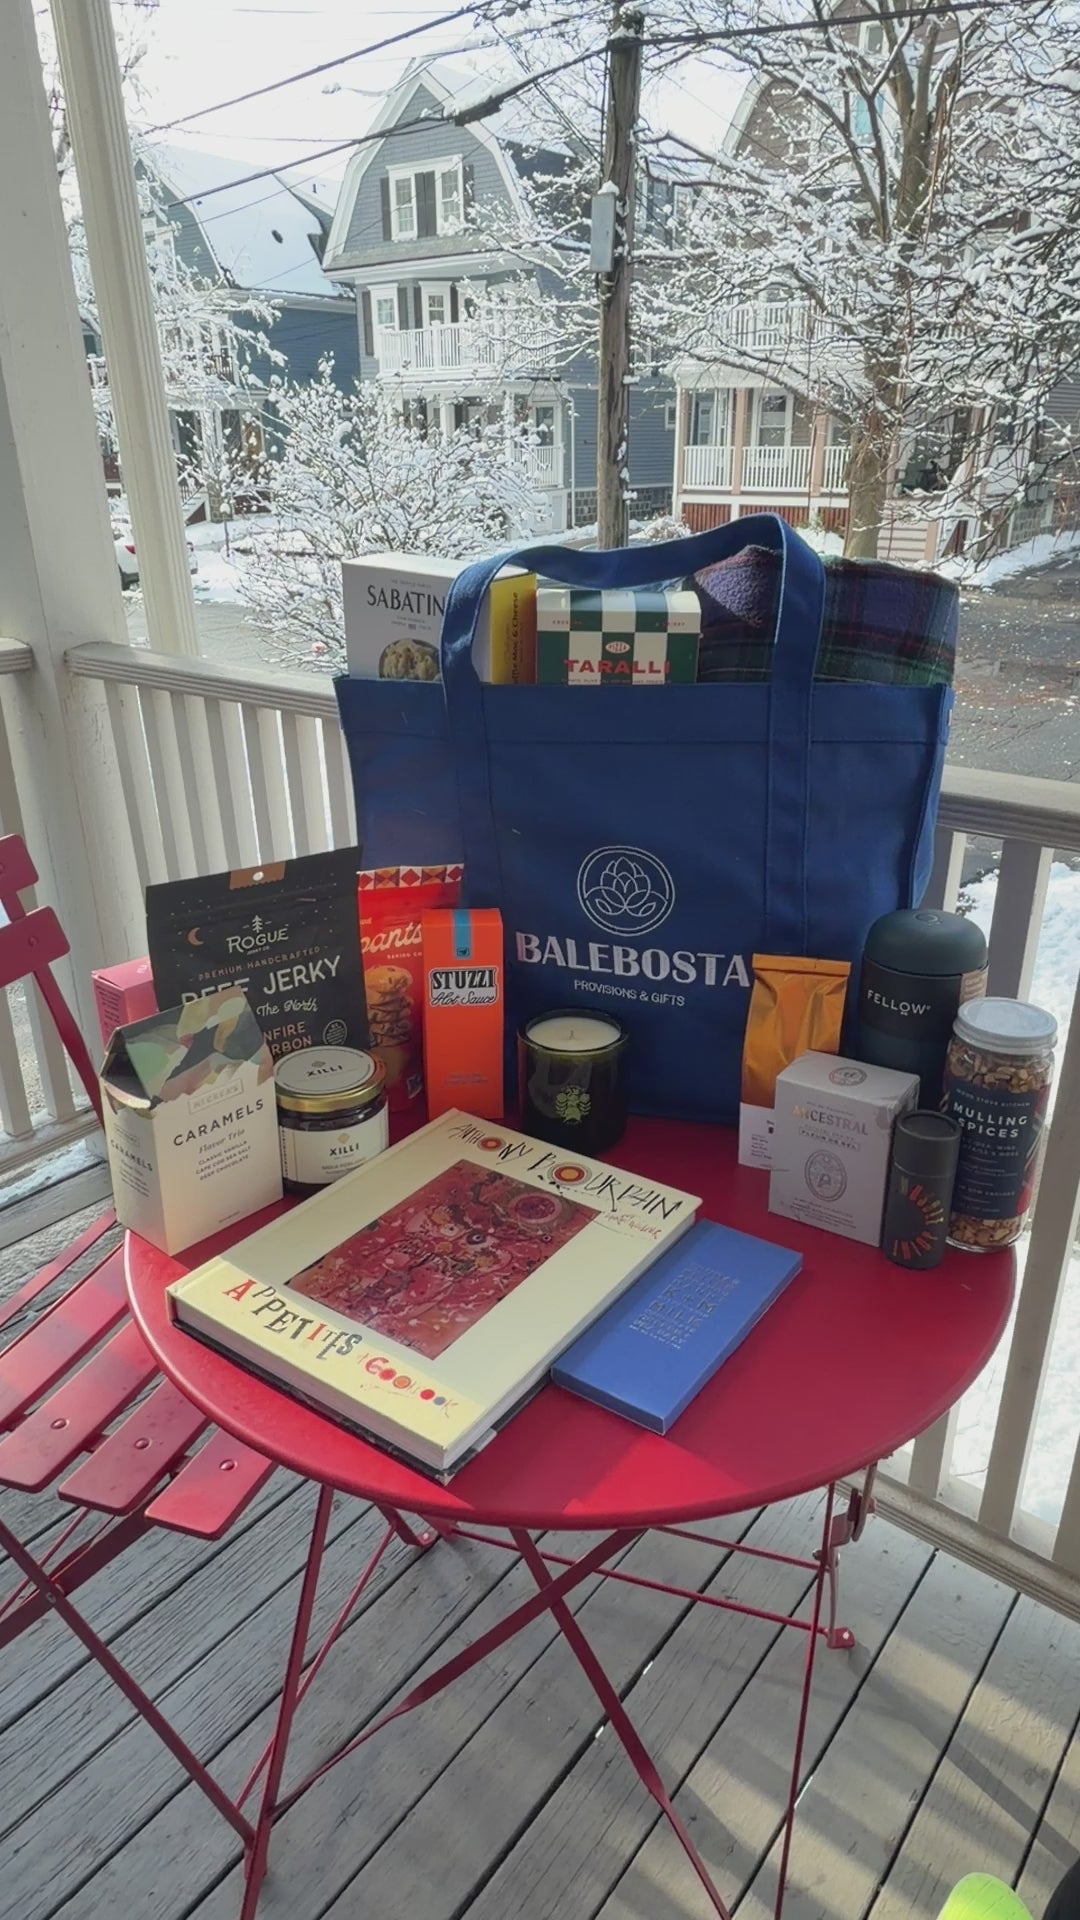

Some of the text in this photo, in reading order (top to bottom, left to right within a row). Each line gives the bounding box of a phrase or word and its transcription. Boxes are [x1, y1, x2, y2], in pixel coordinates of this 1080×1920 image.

[367, 584, 445, 617] SABATIN
[511, 591, 519, 628] Cheese
[563, 659, 672, 674] TARALLI
[226, 927, 289, 954] ROGUE
[198, 946, 321, 981] PREMIUM HANDCRAFTED
[516, 931, 751, 988] BALEBOSTA
[263, 955, 341, 995] JERKY
[432, 969, 496, 990] STUZZI
[431, 990, 496, 1006] Hot Sauce
[574, 979, 686, 1007] PROVISIONS & GIFTS
[256, 997, 319, 1017] The North
[263, 1022, 306, 1041] NFIRE
[271, 1035, 313, 1056] RBON
[306, 1064, 344, 1077] XILLI
[173, 1098, 265, 1147] CARAMELS
[792, 1104, 869, 1136] ANCESTRAL
[953, 1102, 1028, 1126] MULLING
[958, 1118, 1019, 1138] SPICES
[328, 1143, 360, 1157] XILLI
